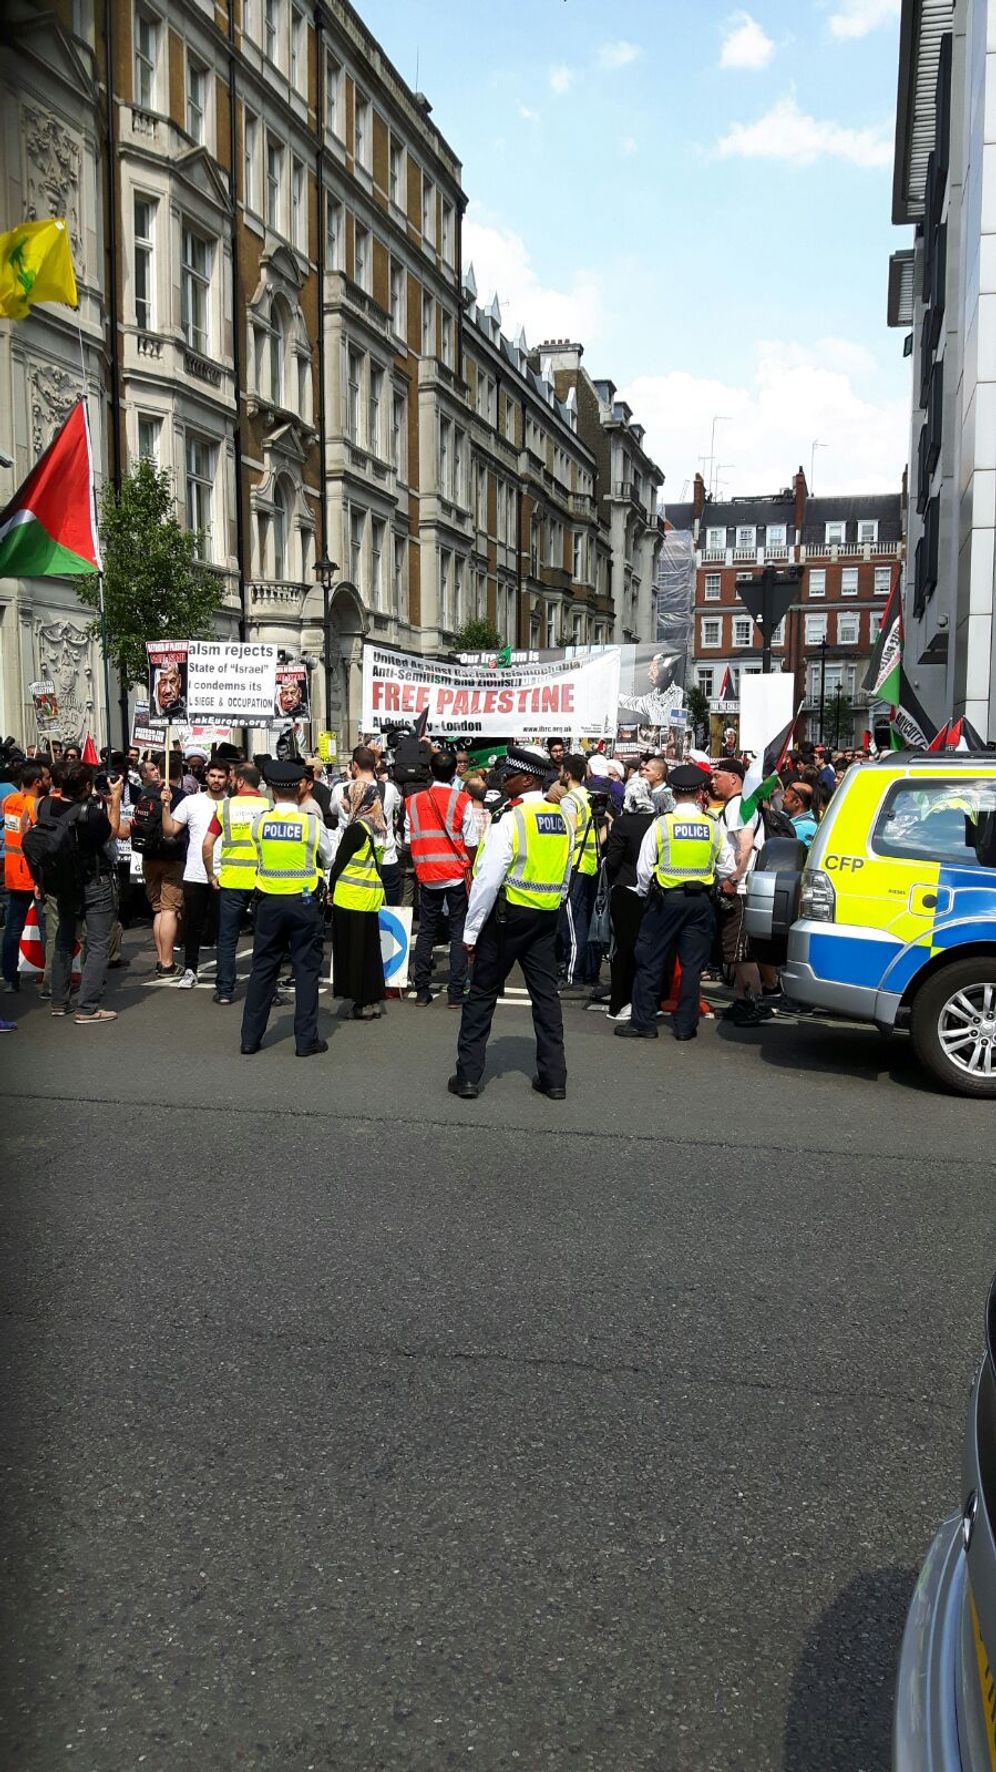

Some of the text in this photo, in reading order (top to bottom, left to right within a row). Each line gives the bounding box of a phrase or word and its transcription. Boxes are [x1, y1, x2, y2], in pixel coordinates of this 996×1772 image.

[225, 644, 273, 659] rejects
[481, 651, 527, 662] freom
[529, 651, 539, 661] is
[189, 662, 215, 673] State
[218, 663, 227, 673] of
[373, 652, 408, 667] United
[411, 660, 452, 675] Against
[372, 665, 451, 685] Anti-Semitism
[194, 680, 246, 691] condemns
[249, 680, 262, 691] its
[194, 697, 214, 707] SIEGE
[218, 697, 224, 707] &
[228, 697, 273, 709] OCCUPATION
[372, 681, 575, 715] FREE PALESTINE
[189, 716, 267, 727] .nkEurope.org
[441, 720, 482, 732] London
[896, 712, 925, 744] BOYCOTT
[264, 823, 301, 839] POLICE
[674, 826, 709, 838] POLICE
[824, 855, 864, 873] CFP
